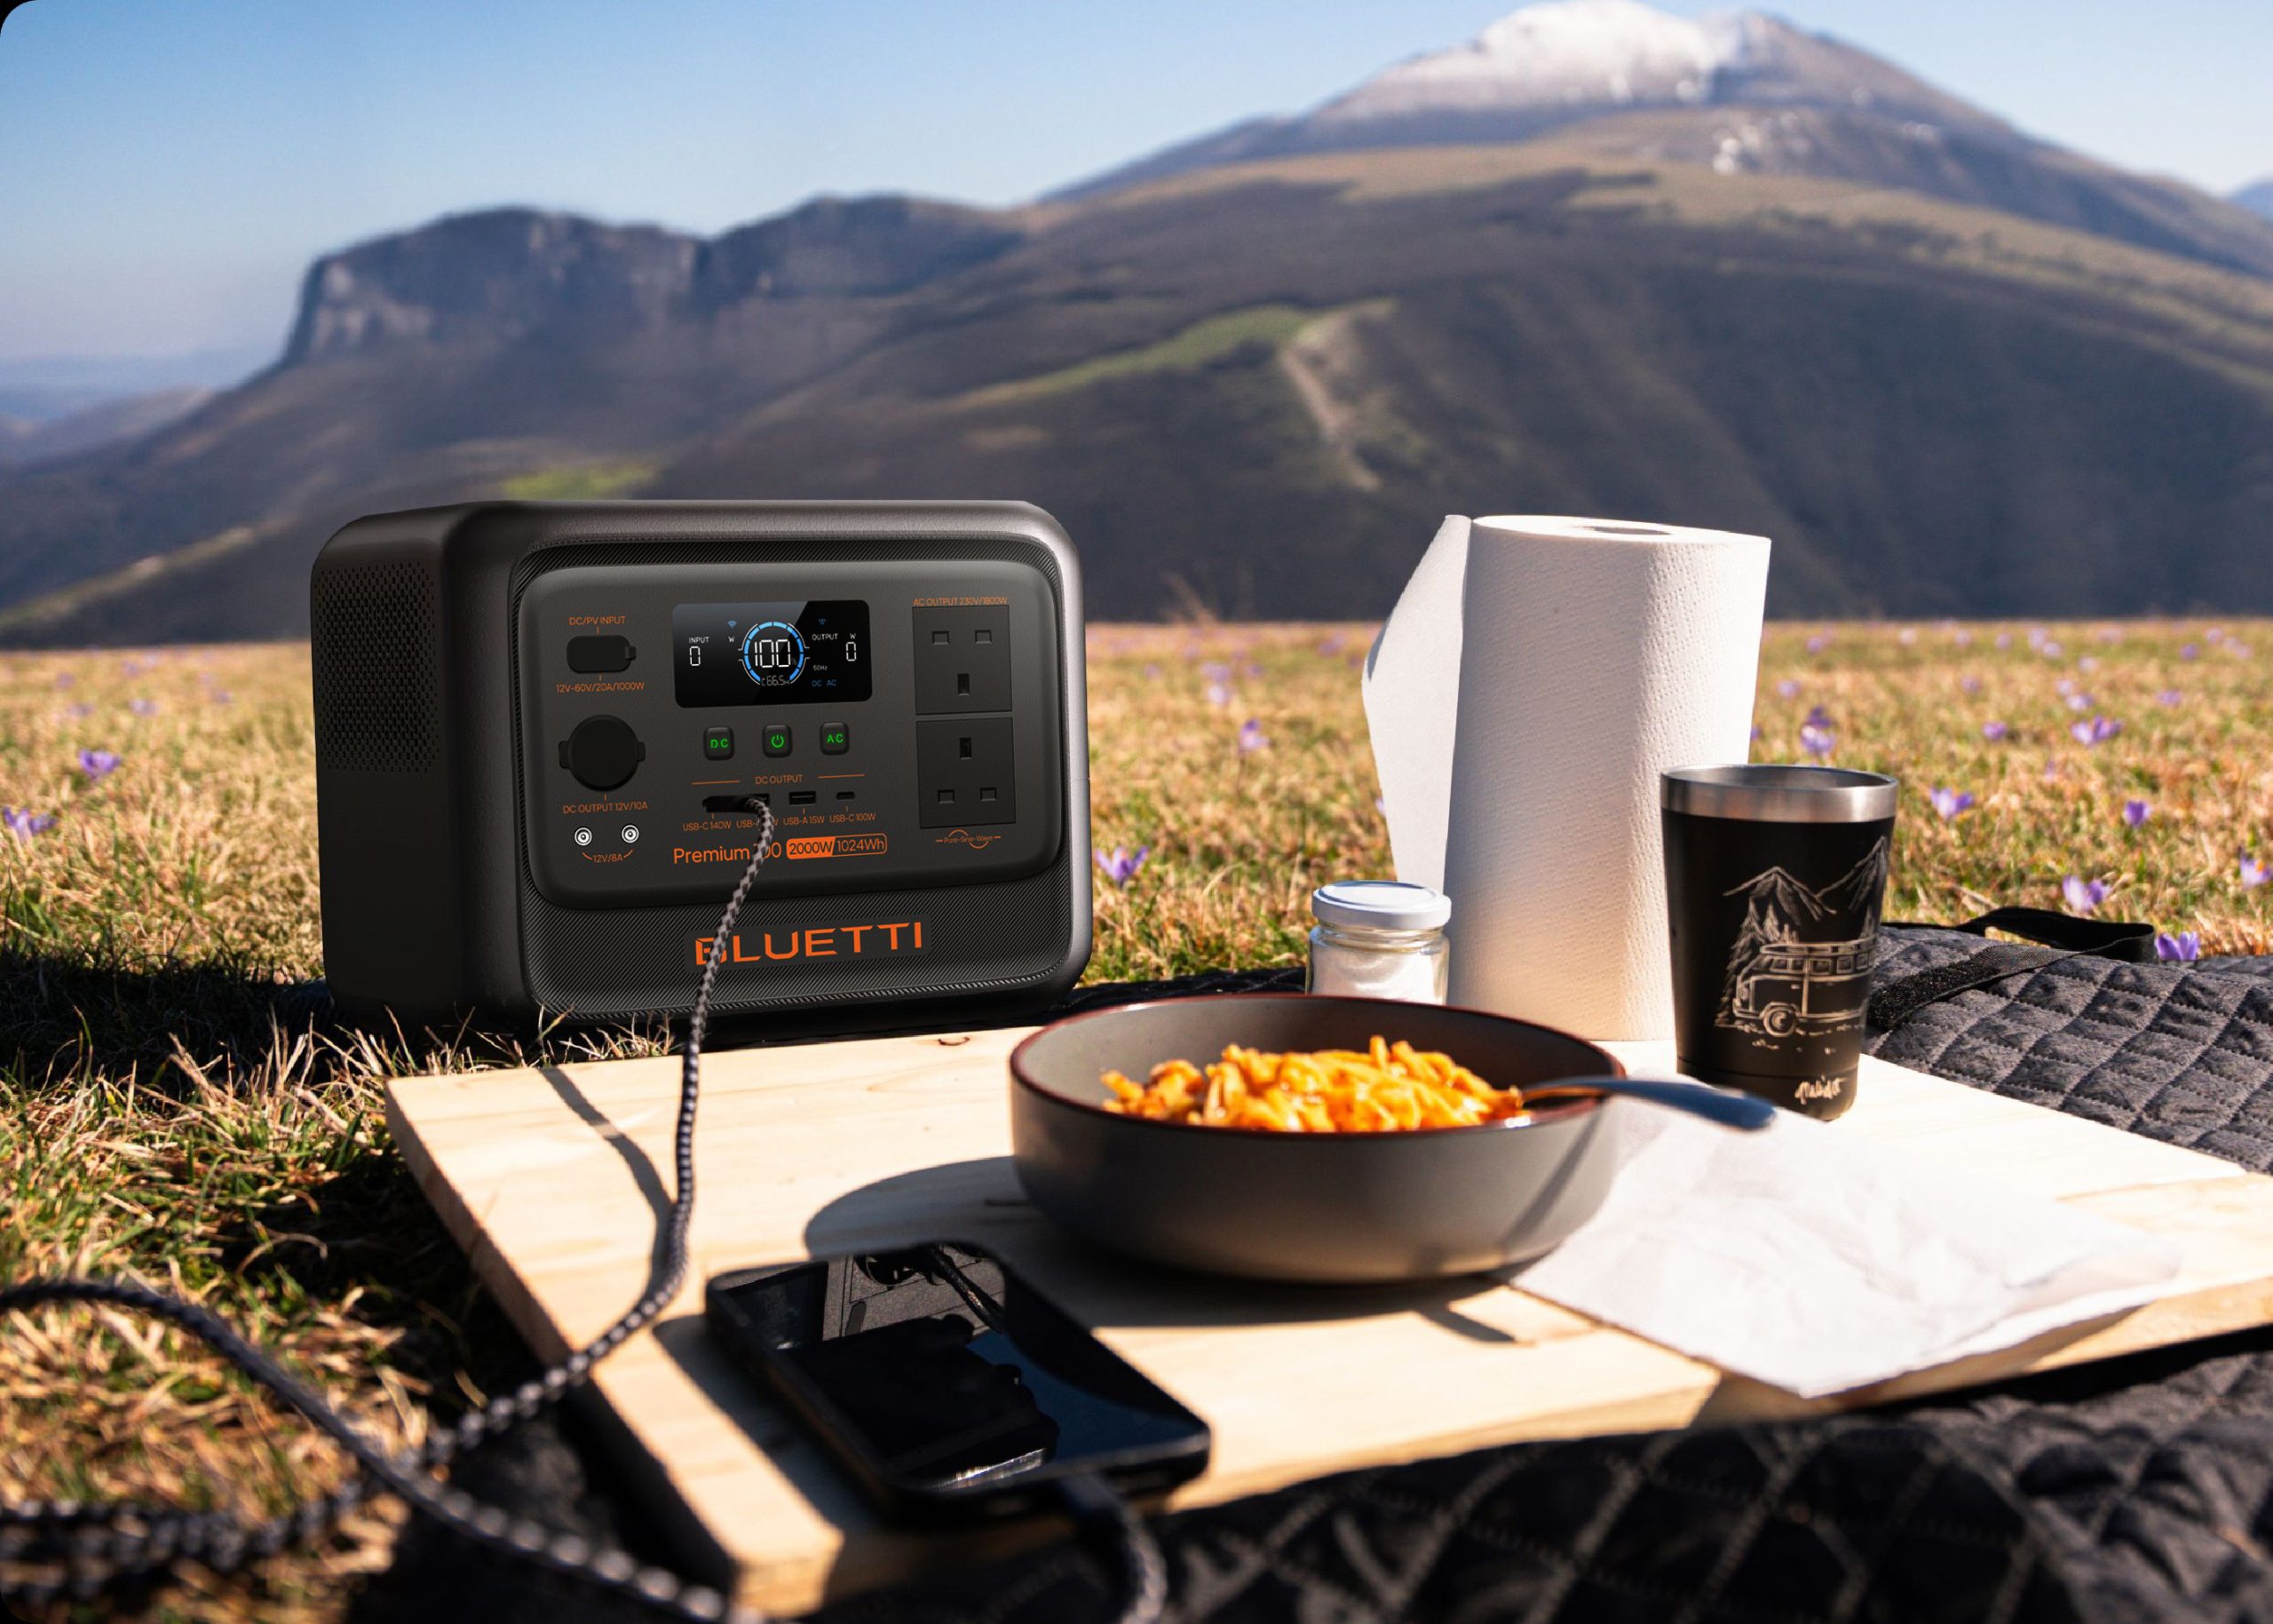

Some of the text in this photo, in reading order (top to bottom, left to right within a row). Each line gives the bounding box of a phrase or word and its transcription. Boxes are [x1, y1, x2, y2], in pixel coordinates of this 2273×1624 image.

[927, 597, 958, 606] OUTPUT
[960, 596, 1008, 606] 230V/1800W
[568, 615, 626, 626] DC/PV INPUT
[689, 646, 701, 667] 0
[845, 641, 857, 662] 0
[827, 678, 837, 687] AC
[710, 738, 729, 749] DC
[827, 733, 844, 744] AC
[756, 774, 804, 785] DC OUTPUT
[563, 801, 648, 814] DC OUTPUT 12V/10A
[783, 816, 808, 826] USB-A
[810, 815, 825, 824] 15W
[829, 812, 876, 823] USB-C 100W
[682, 820, 732, 832] USB-C 140W
[673, 845, 750, 864] Premium
[789, 840, 833, 855] 2000W
[836, 838, 884, 852] 1024Wh
[593, 853, 623, 863] 12V/8A
[695, 922, 923, 966] BLUETTI
